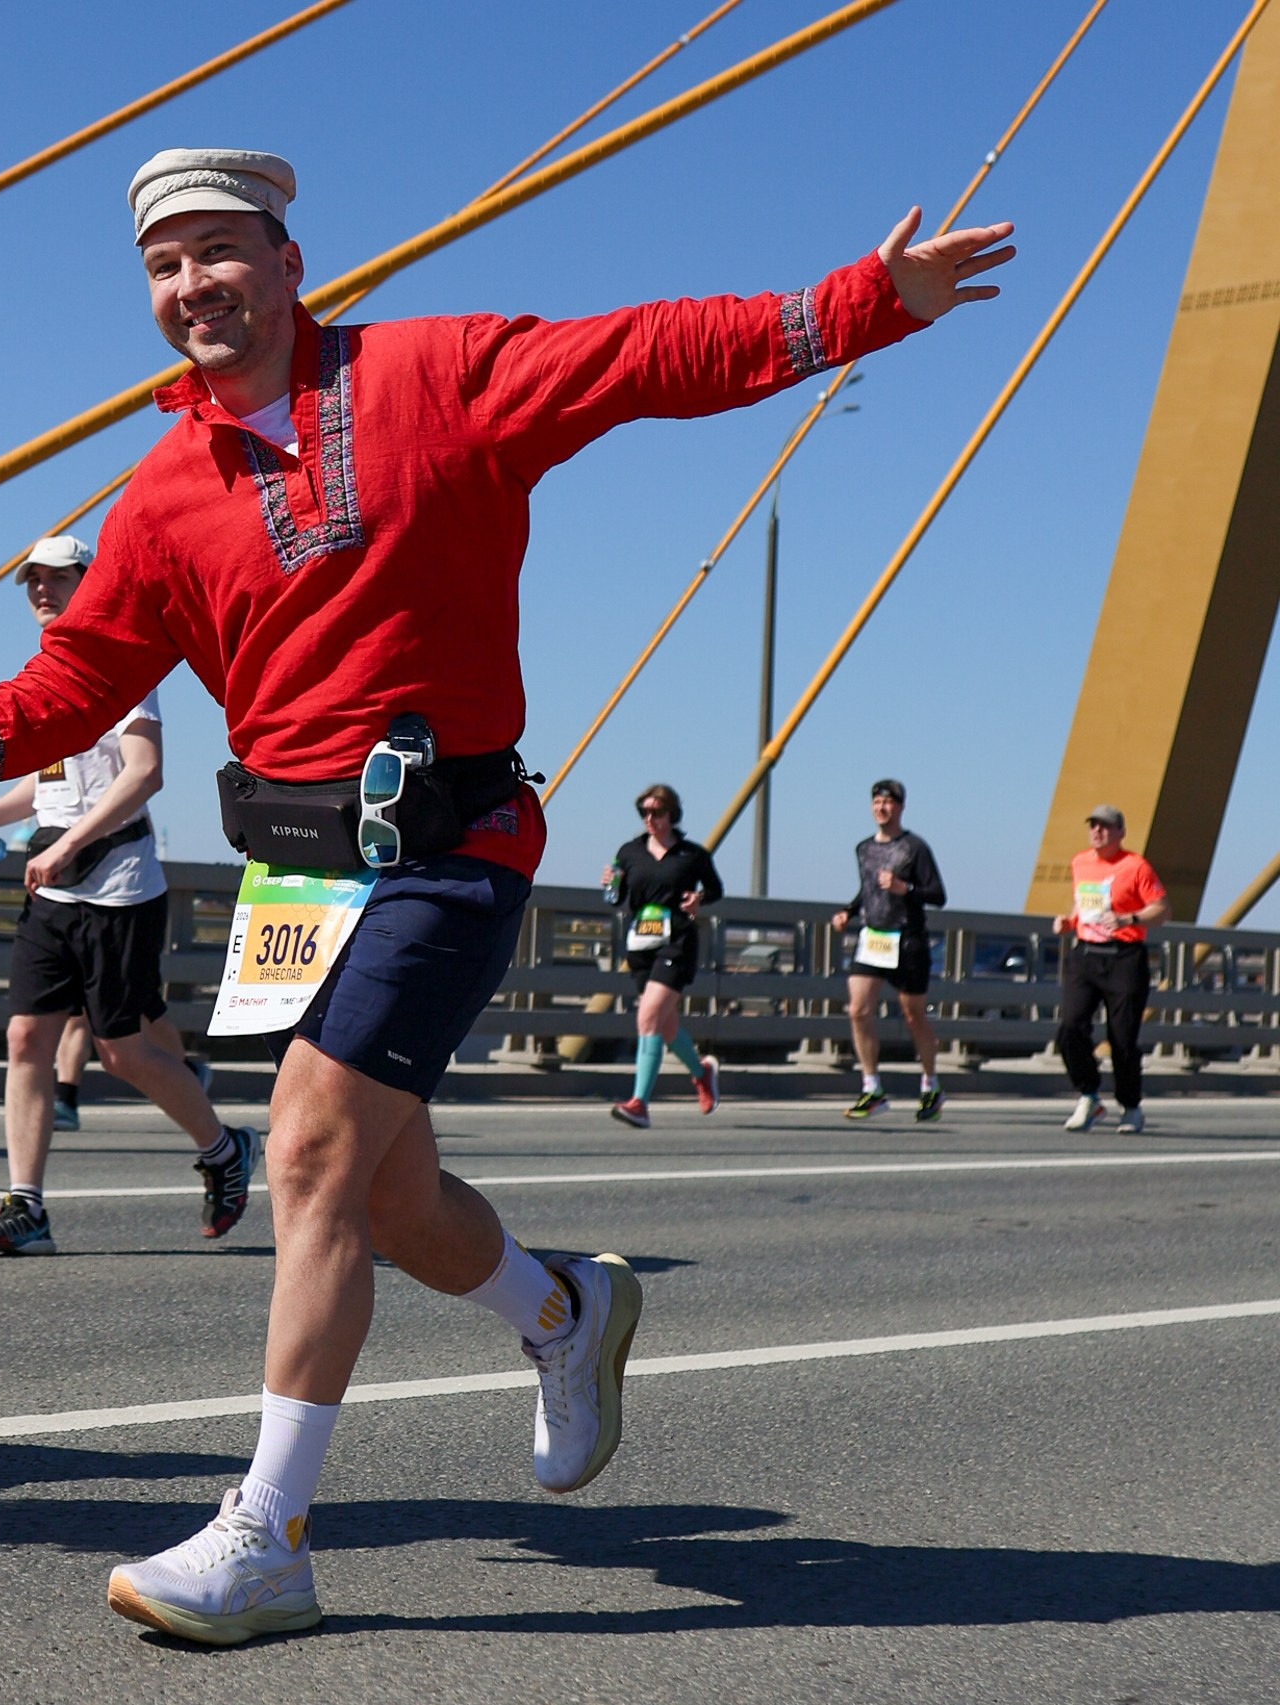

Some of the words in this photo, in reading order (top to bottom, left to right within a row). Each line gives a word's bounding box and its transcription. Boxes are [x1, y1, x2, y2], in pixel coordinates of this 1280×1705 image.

[271, 825, 319, 840] KIPRUN
[232, 935, 243, 954] E
[256, 923, 320, 965] 3016
[259, 968, 304, 981] ВЯЧЕСЛАВ
[239, 997, 269, 1007] МАГНИТ
